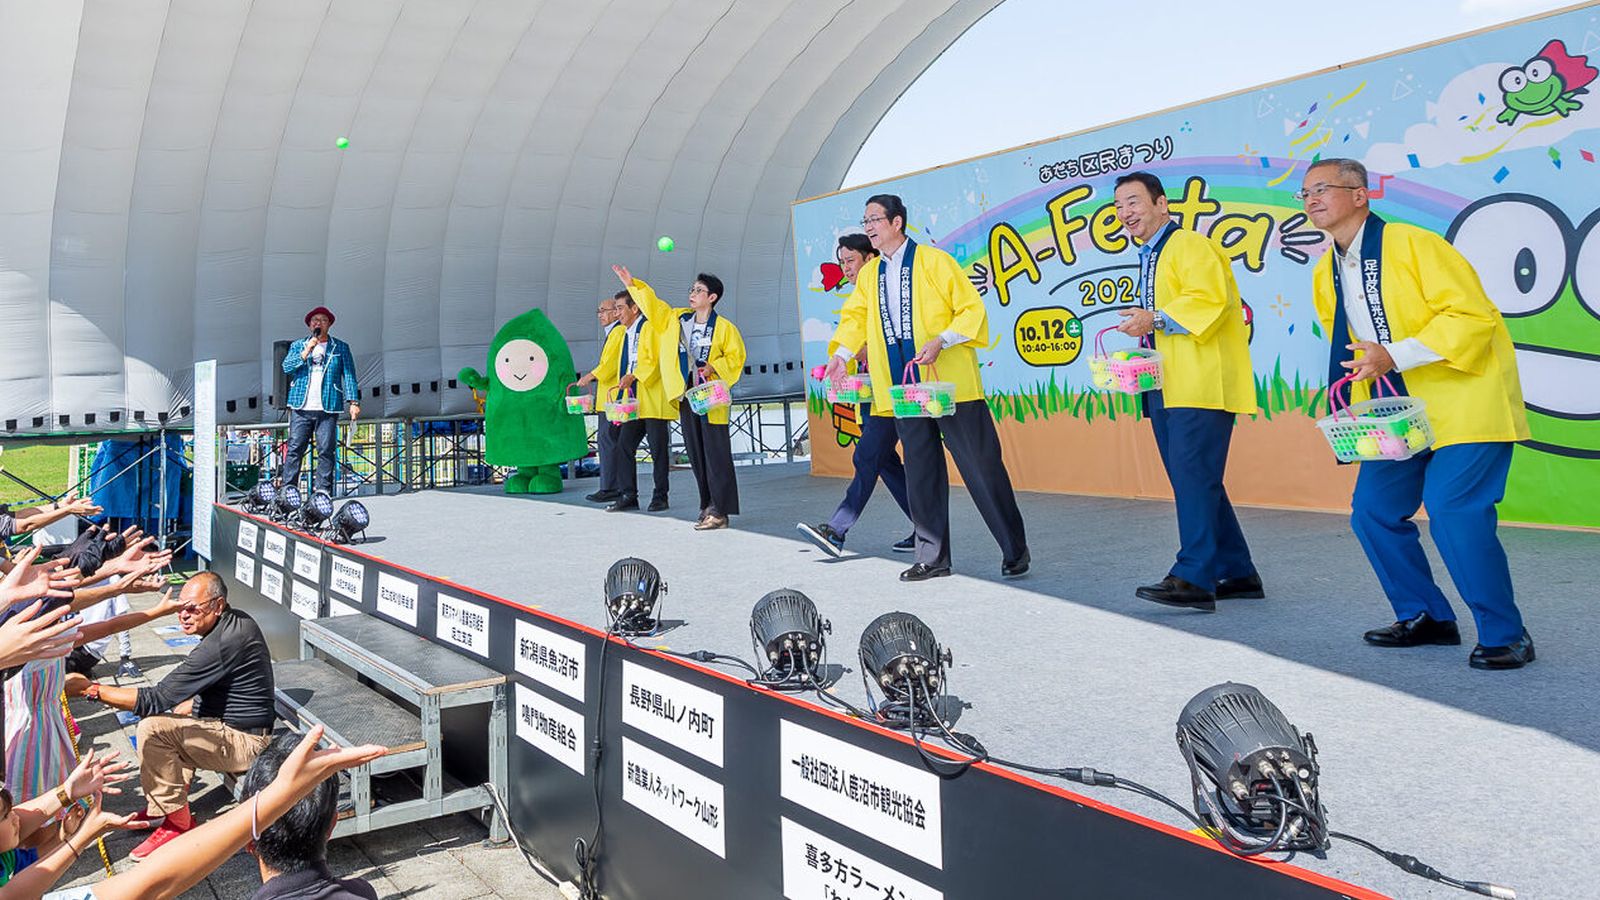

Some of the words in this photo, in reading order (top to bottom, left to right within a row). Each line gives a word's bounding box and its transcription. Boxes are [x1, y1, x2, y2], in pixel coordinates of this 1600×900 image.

[1039, 136, 1174, 183] あだち区民まつり
[988, 176, 1275, 307] A-Feta
[1020, 319, 1064, 341] 10.12
[1068, 321, 1080, 334] 土
[1022, 341, 1077, 353] 10:40-16:00
[520, 637, 579, 681] 新潟県魚沼市
[521, 703, 577, 752] 鳴門物産組合
[629, 684, 714, 739] 長野県山ノ内町
[627, 760, 718, 828] 新農業人ネットワーク山形
[791, 753, 926, 830] 一般社団法人鹿沼市観光協会
